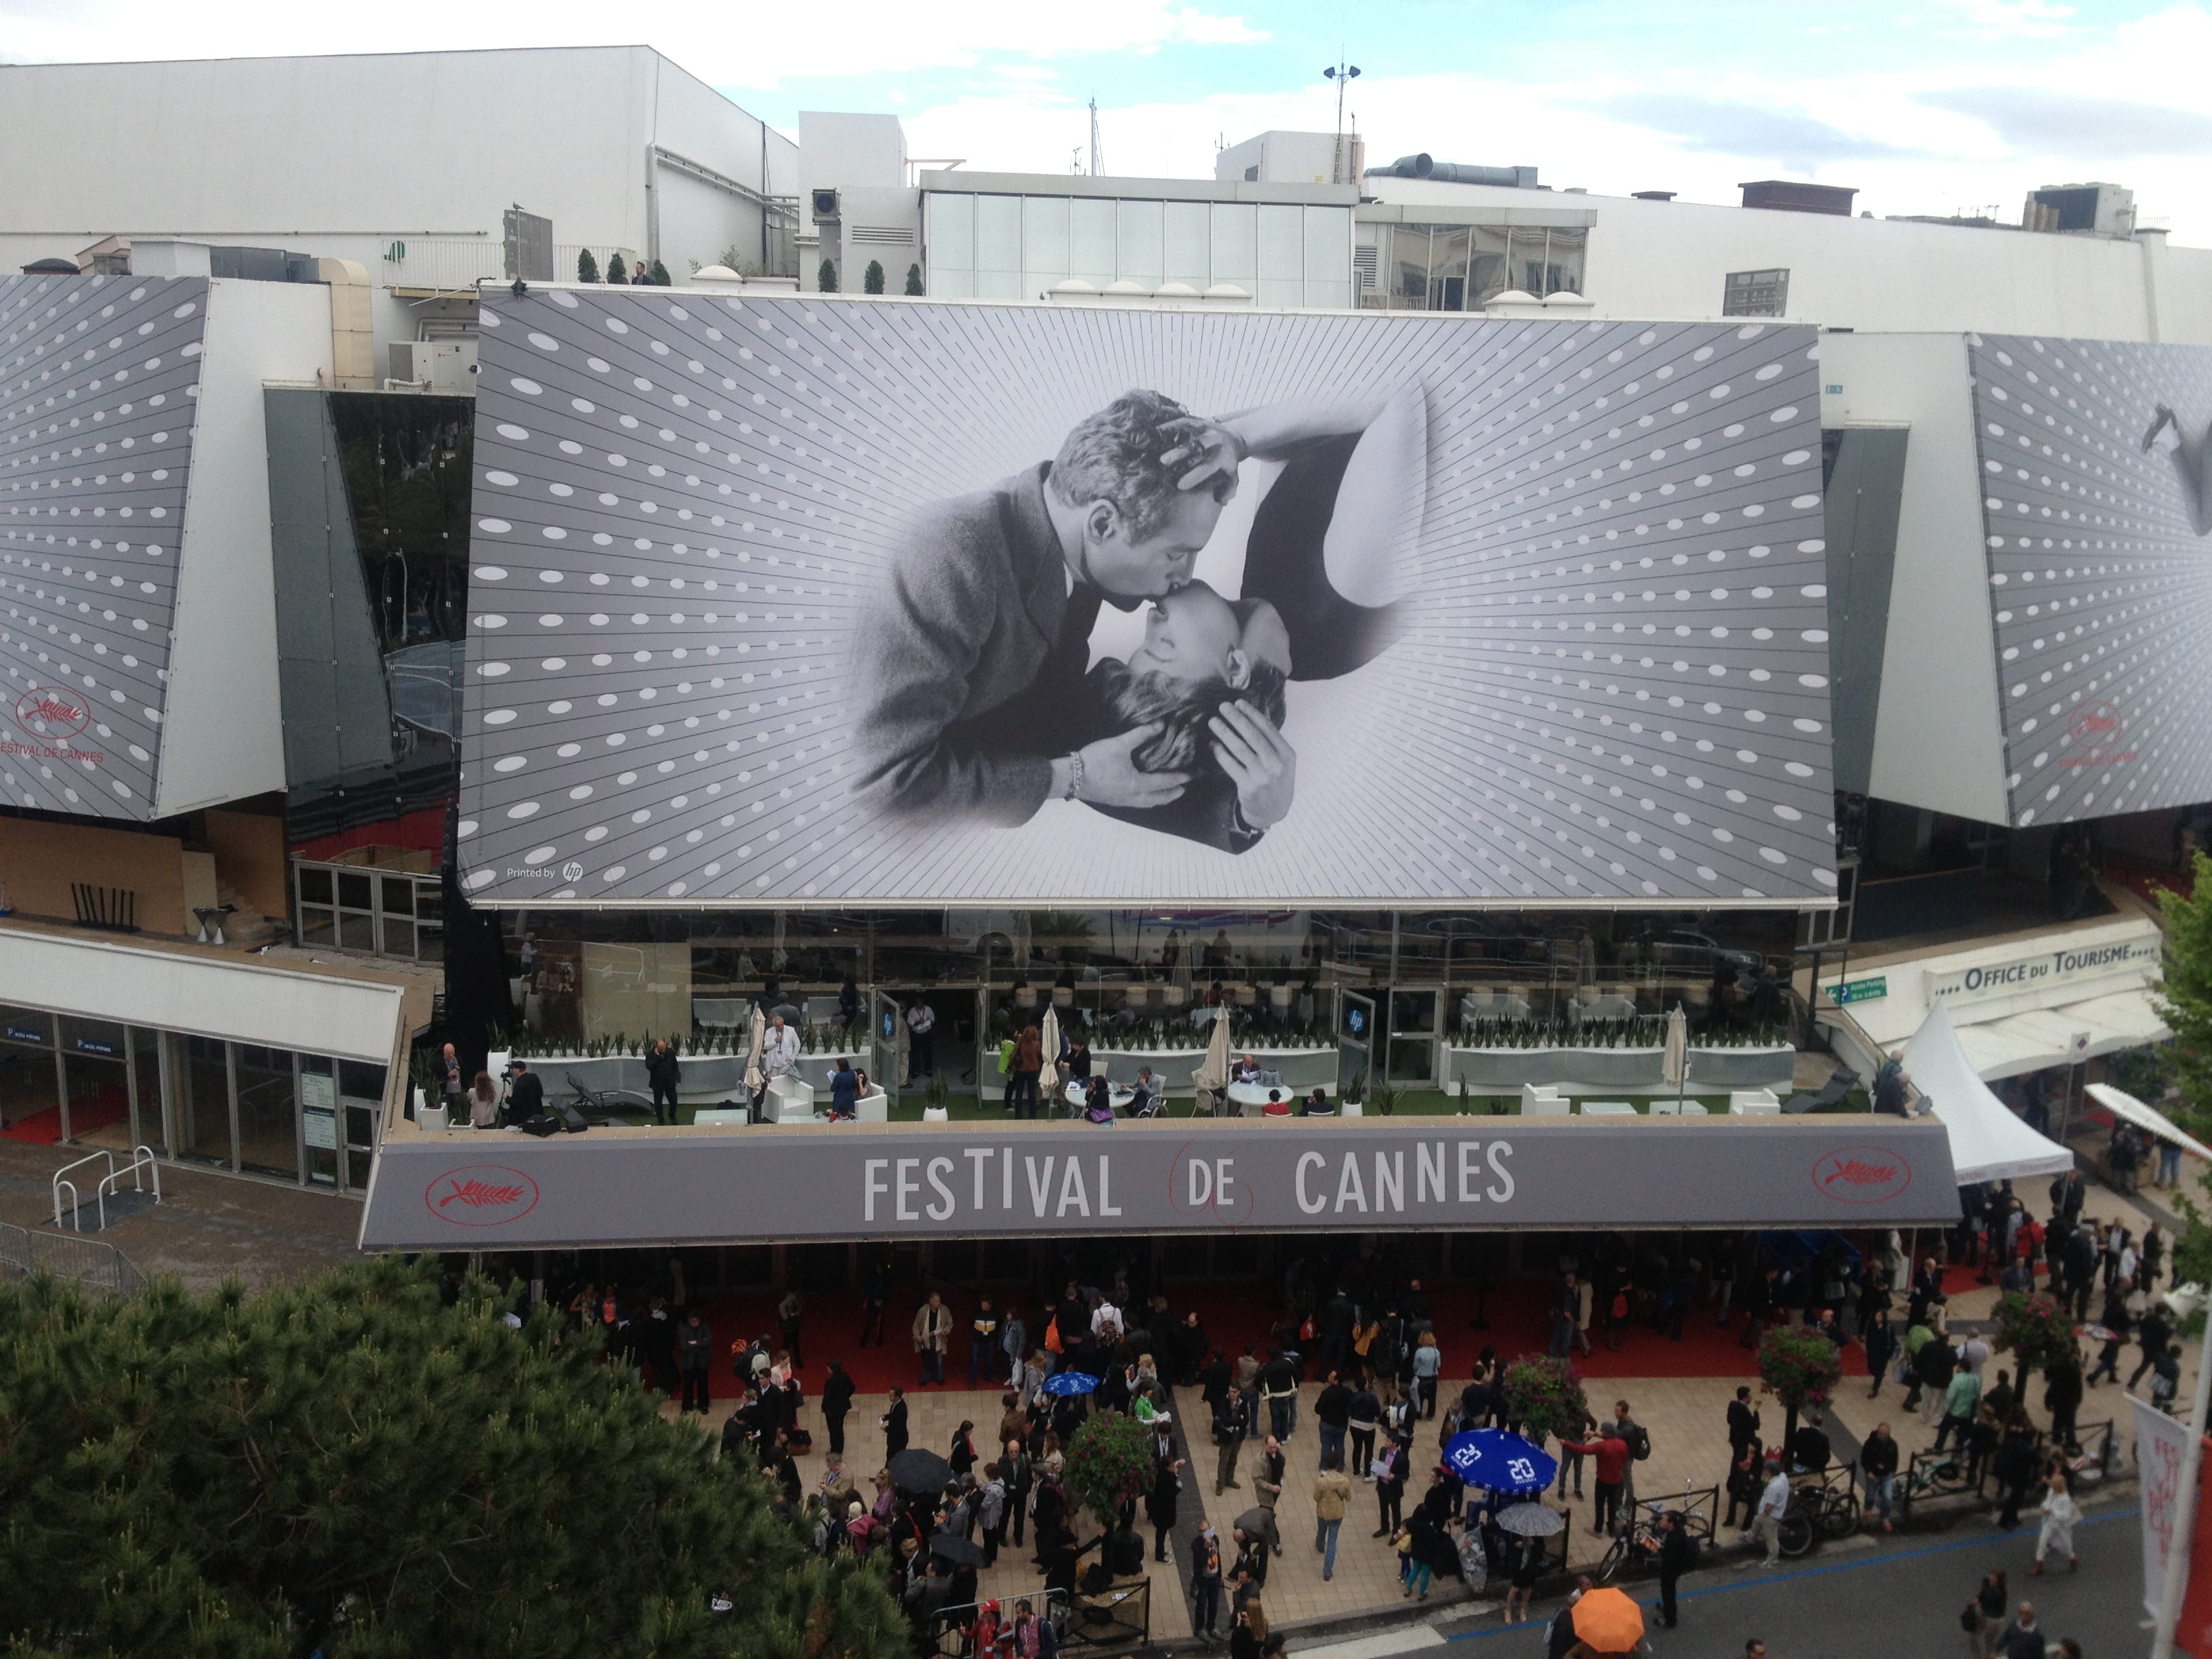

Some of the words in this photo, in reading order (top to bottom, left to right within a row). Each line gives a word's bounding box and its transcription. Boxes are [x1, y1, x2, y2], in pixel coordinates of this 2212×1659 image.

[0, 743, 41, 757] ESTIVAL
[43, 747, 57, 758] DE
[60, 749, 104, 762] CANNES
[508, 868, 541, 877] Printed
[544, 868, 555, 878] by
[563, 862, 583, 881] hp
[1965, 964, 2026, 991] OFFICE
[1349, 1010, 1363, 1031] hp
[865, 1147, 1122, 1221] FESTIVAL
[1189, 1159, 1234, 1206] DE
[1295, 1141, 1515, 1214] CANNES
[1455, 1443, 1482, 1467] 20
[1507, 1458, 1535, 1480] 20
